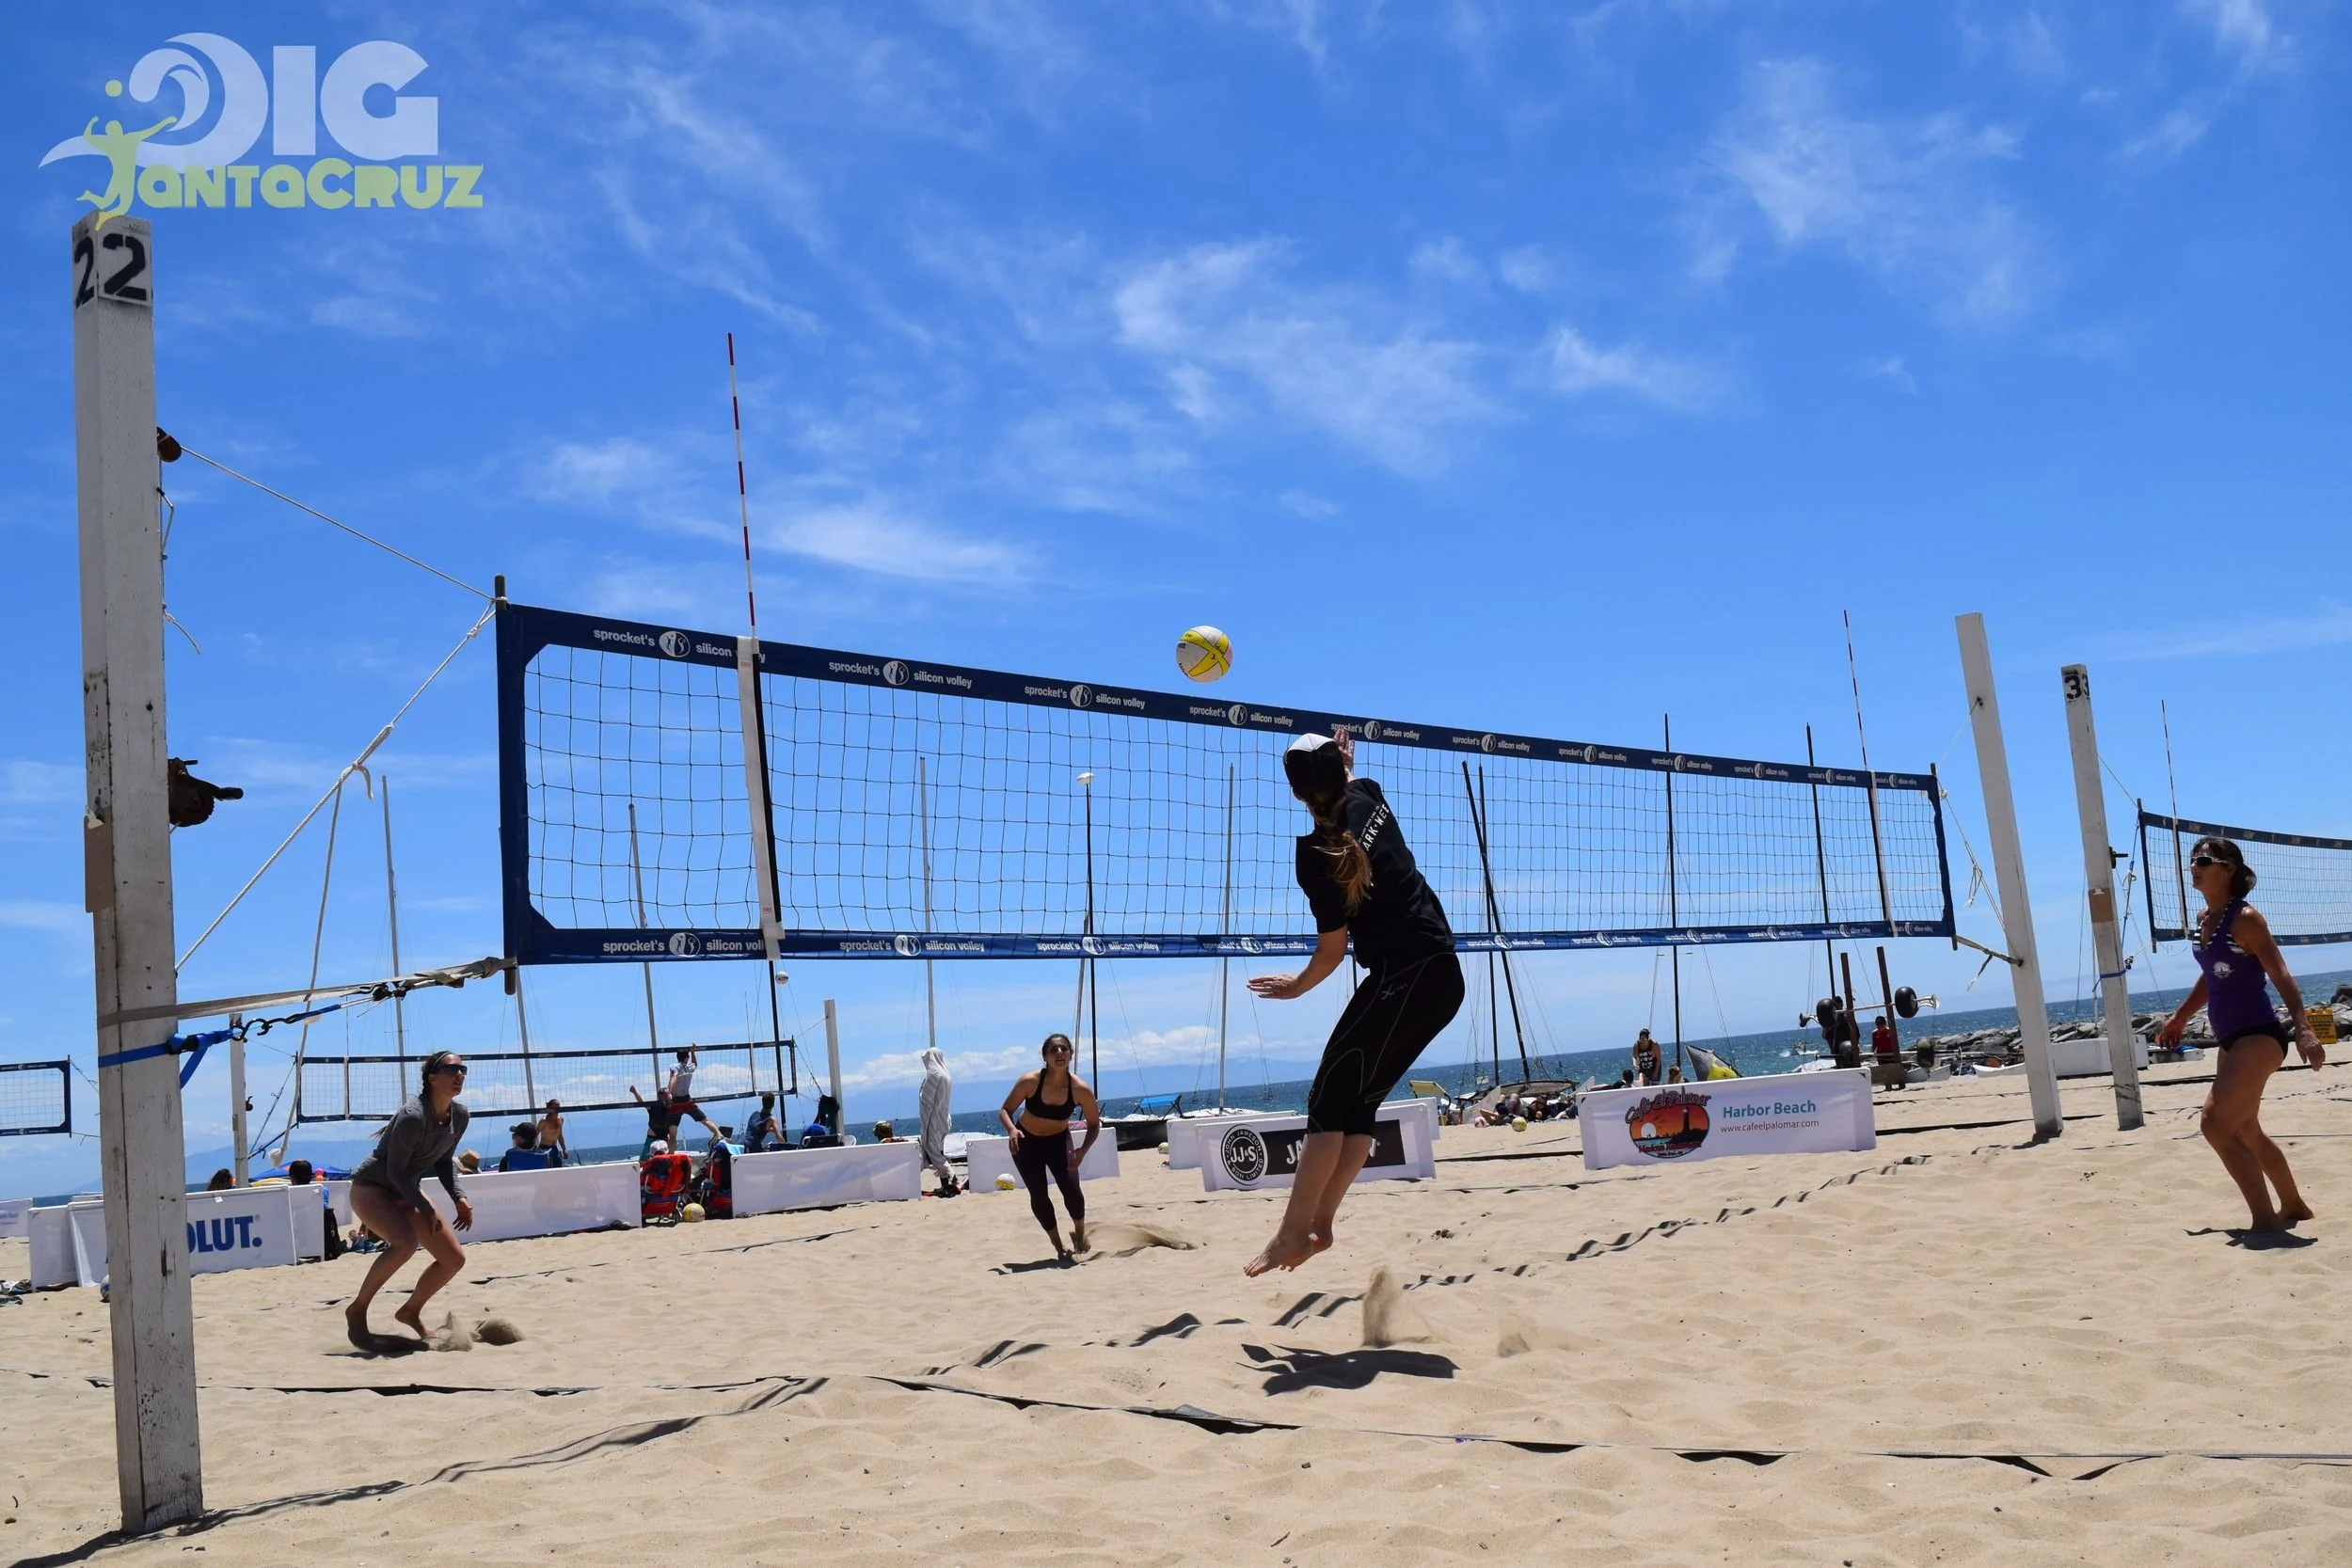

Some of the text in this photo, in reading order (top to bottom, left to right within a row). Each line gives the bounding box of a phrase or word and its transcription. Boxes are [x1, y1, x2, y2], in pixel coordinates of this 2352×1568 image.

[593, 628, 656, 647] sprocket's
[695, 643, 732, 657] silicon
[829, 661, 972, 689] sprocket's silicon volley
[2064, 675, 2082, 700] 3
[1025, 685, 1145, 710] sprocket's silicon volley
[1189, 705, 1294, 727] sprocket's silicon volley
[1383, 727, 1402, 737] silicon
[1403, 731, 1421, 741] volley
[1498, 740, 1515, 750] silicon
[1362, 826, 1378, 851] ARK
[1374, 803, 1390, 826] WEE
[602, 939, 766, 954] sprocket's silicon voll
[839, 940, 985, 953] sprocket's silicon volley
[1037, 941, 1081, 952] sprocket's
[1108, 941, 1136, 950] silicon
[1665, 1085, 1711, 1106] Palomar
[1723, 1100, 1817, 1118] Harbor Beach
[1720, 1119, 1820, 1132] www.cafeelpalomar.com
[1231, 1146, 1256, 1163] JJ&S
[187, 1215, 262, 1254] LUT.
